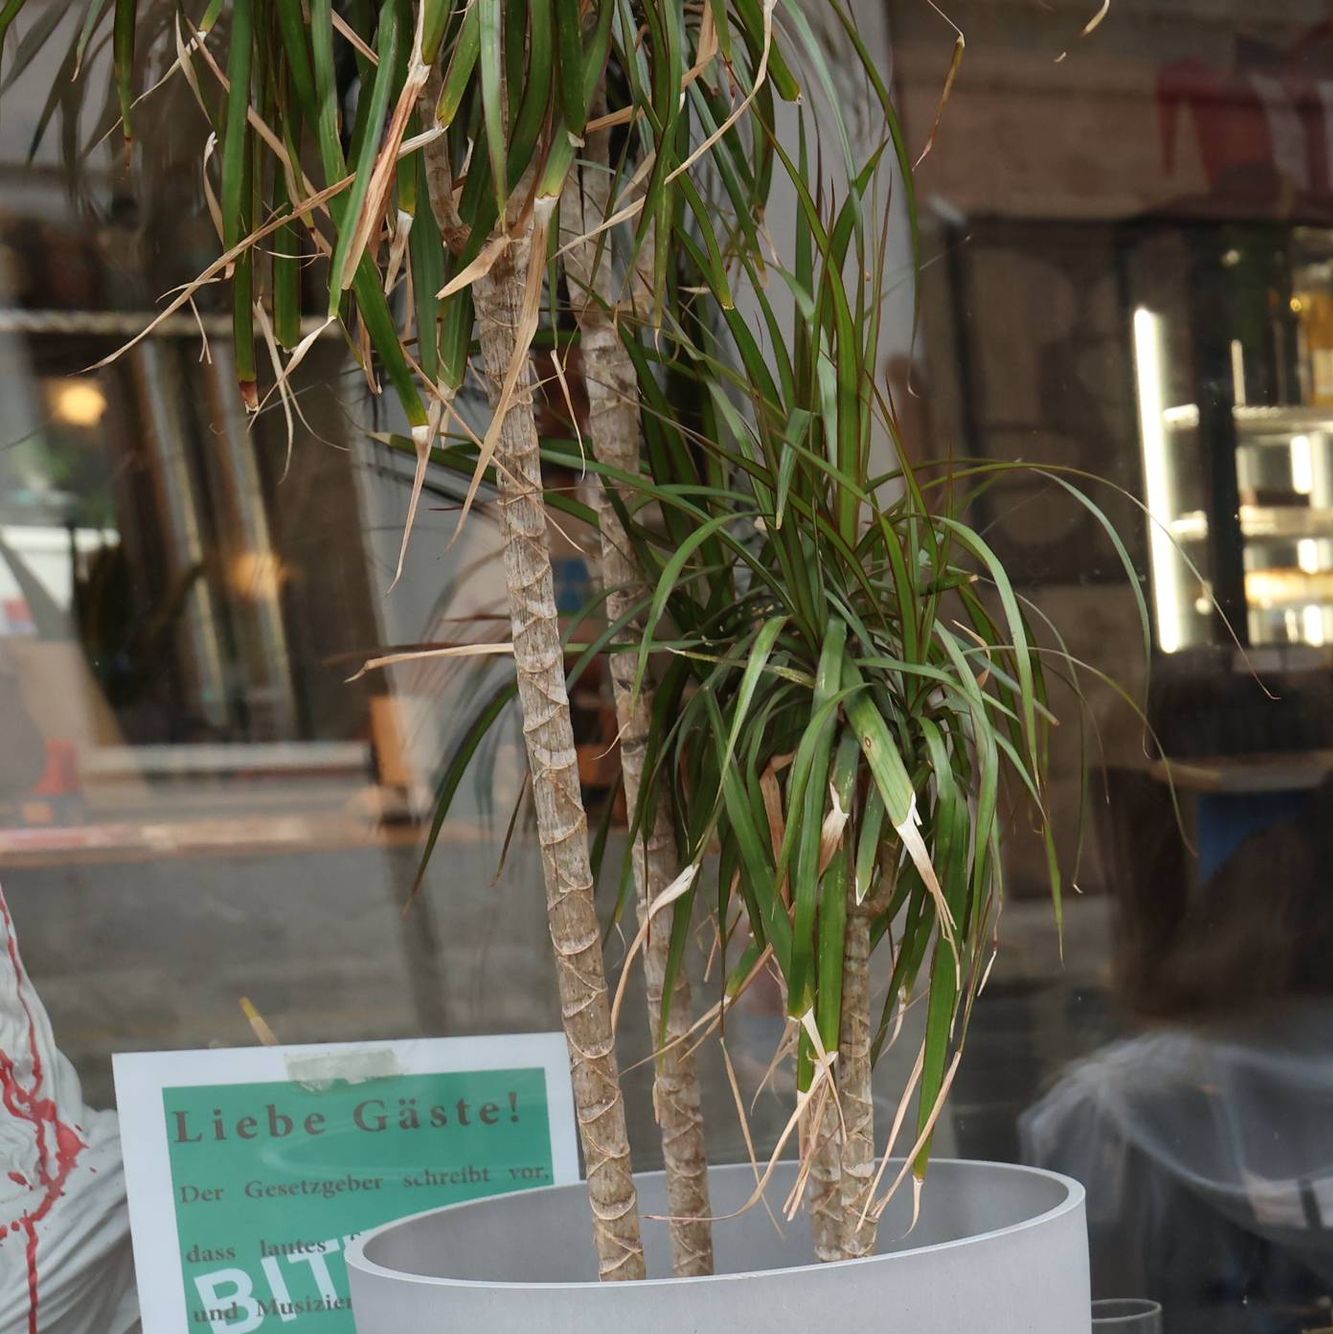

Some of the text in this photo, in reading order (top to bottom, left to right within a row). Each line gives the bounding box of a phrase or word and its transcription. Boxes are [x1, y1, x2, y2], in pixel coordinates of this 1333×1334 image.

[173, 1092, 520, 1142] Liebe Gäste!
[181, 1165, 549, 1203] Der Gesetzgeber schreibt vor,
[186, 1238, 327, 1263] dass lautes
[194, 1301, 238, 1322] und
